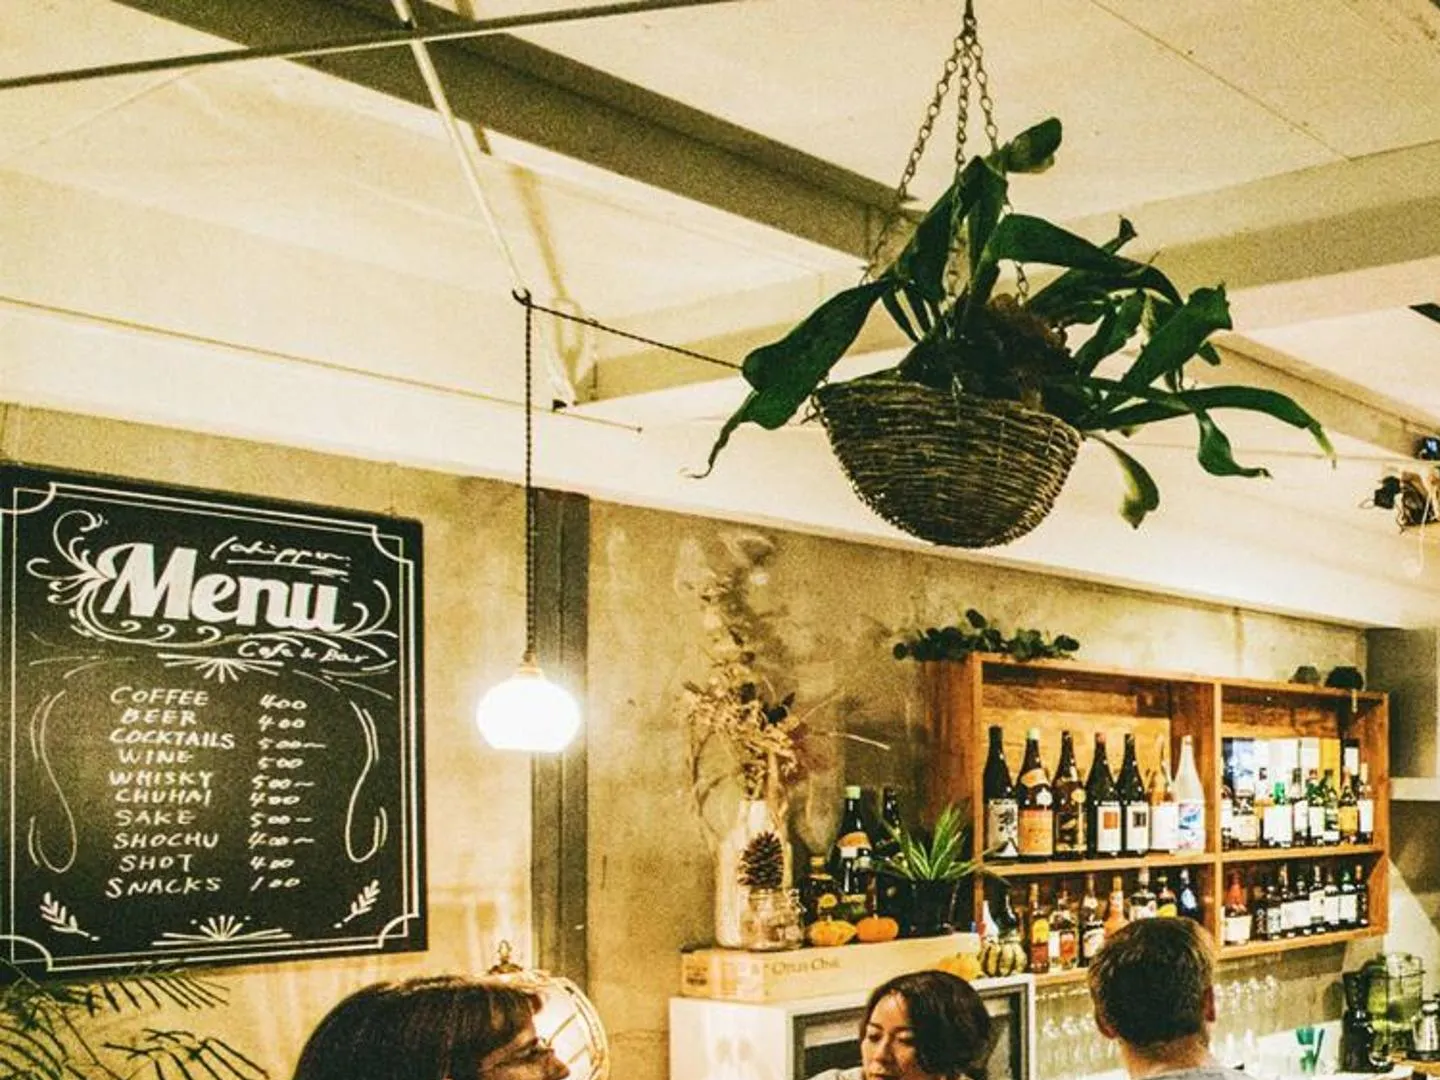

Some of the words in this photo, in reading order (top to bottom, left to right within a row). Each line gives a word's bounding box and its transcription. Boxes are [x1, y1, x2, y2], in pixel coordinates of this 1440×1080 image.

[98, 542, 346, 632] Menu
[237, 641, 294, 659] Cafe
[319, 648, 369, 663] Bar
[110, 686, 209, 707] COFFEE
[259, 693, 308, 710] 400
[120, 707, 197, 726] BEER
[258, 714, 306, 732] 400
[109, 727, 236, 750] COCKTAILS
[118, 748, 194, 765] WINE
[109, 769, 214, 789] WHISKY
[114, 788, 212, 807] CHUHAI
[248, 792, 301, 808] 400
[114, 809, 197, 827] SAKE
[113, 832, 219, 850] SHOCHU
[118, 853, 194, 873] SHOT
[105, 876, 223, 899] SNACKS
